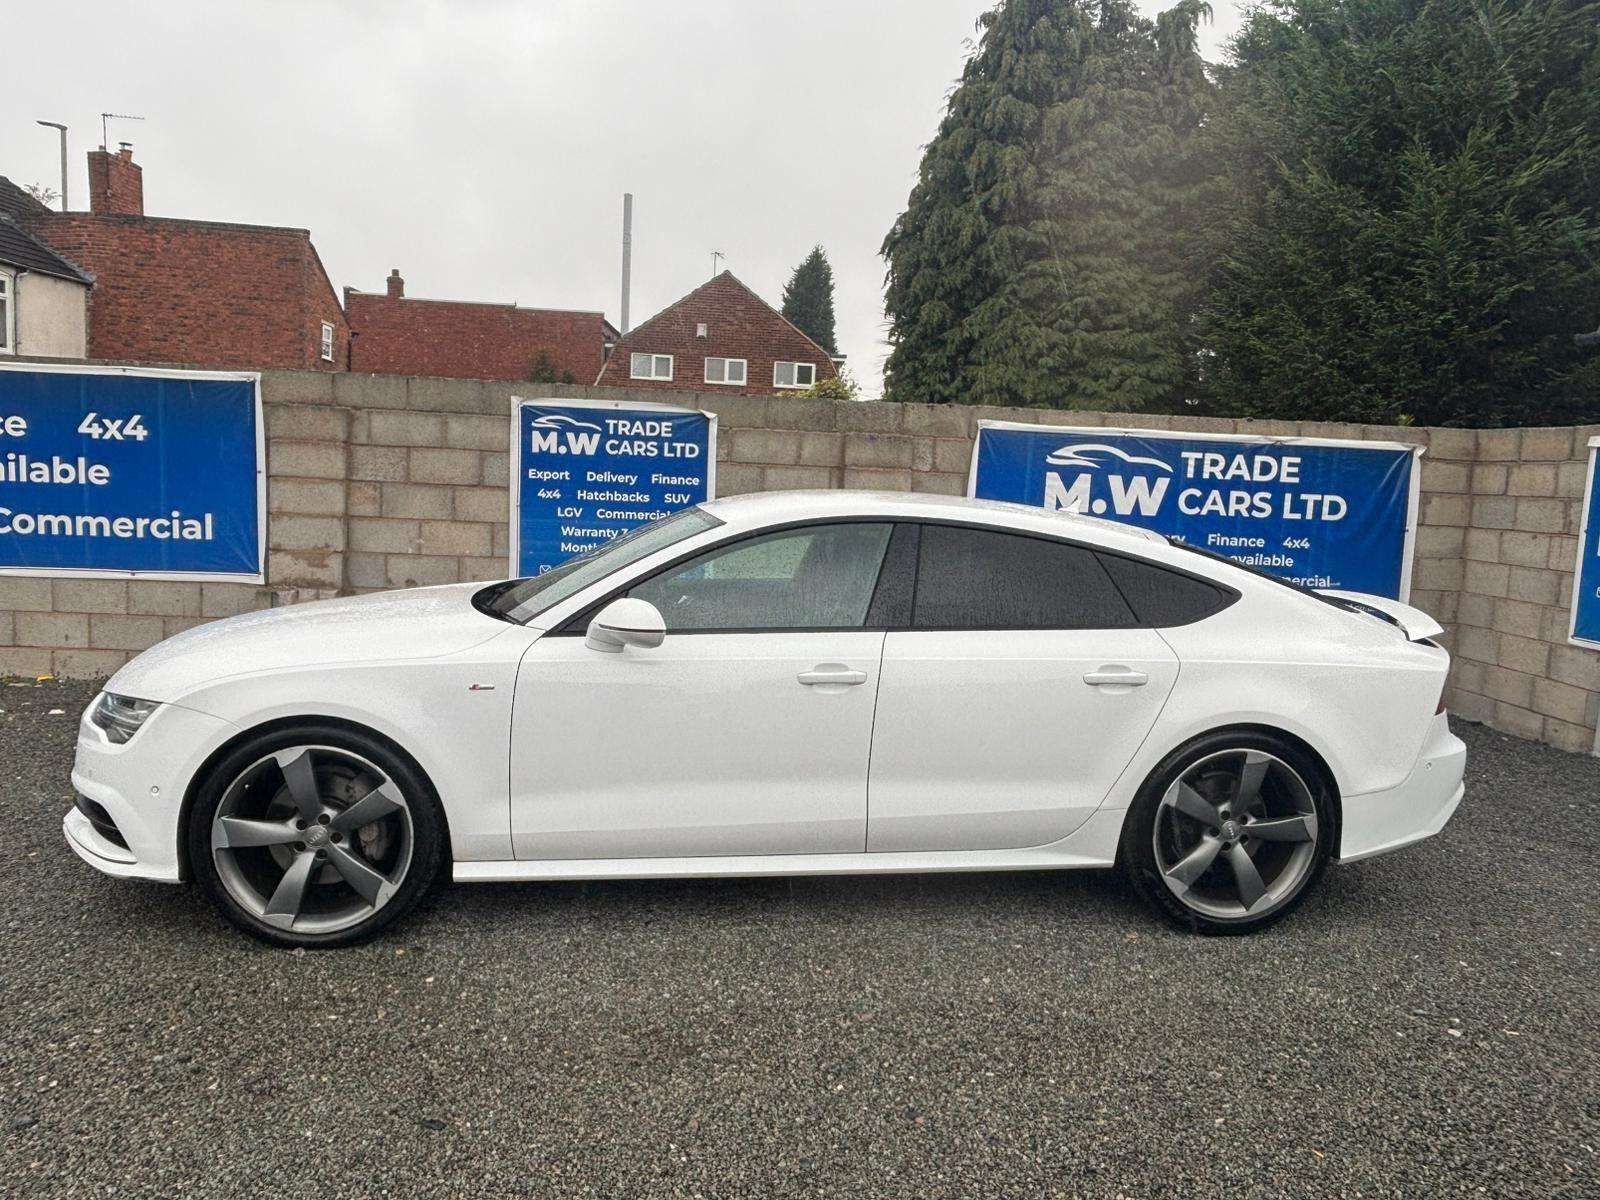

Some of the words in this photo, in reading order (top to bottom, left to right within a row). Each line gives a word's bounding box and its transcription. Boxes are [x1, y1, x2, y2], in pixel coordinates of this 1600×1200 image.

[78, 412, 149, 441] 4x4
[605, 419, 673, 437] TRADE
[531, 431, 601, 455] M.W
[605, 440, 658, 456] CARS
[663, 442, 700, 458] LTD
[0, 452, 110, 485] ilable
[1181, 451, 1302, 483] TRADE
[528, 468, 570, 481] Export
[586, 471, 638, 486] Delivery
[651, 474, 700, 486] Finance
[537, 488, 562, 499] 4x4
[577, 490, 650, 502] Hatchbacks
[664, 493, 691, 504] SUV
[1043, 471, 1171, 516] M.W
[557, 507, 583, 517] LGV
[1178, 488, 1273, 518] CARS
[1282, 493, 1348, 521] LTD
[561, 526, 618, 539] Warranty
[1207, 533, 1266, 548] Finance
[1282, 536, 1310, 550] 4x4
